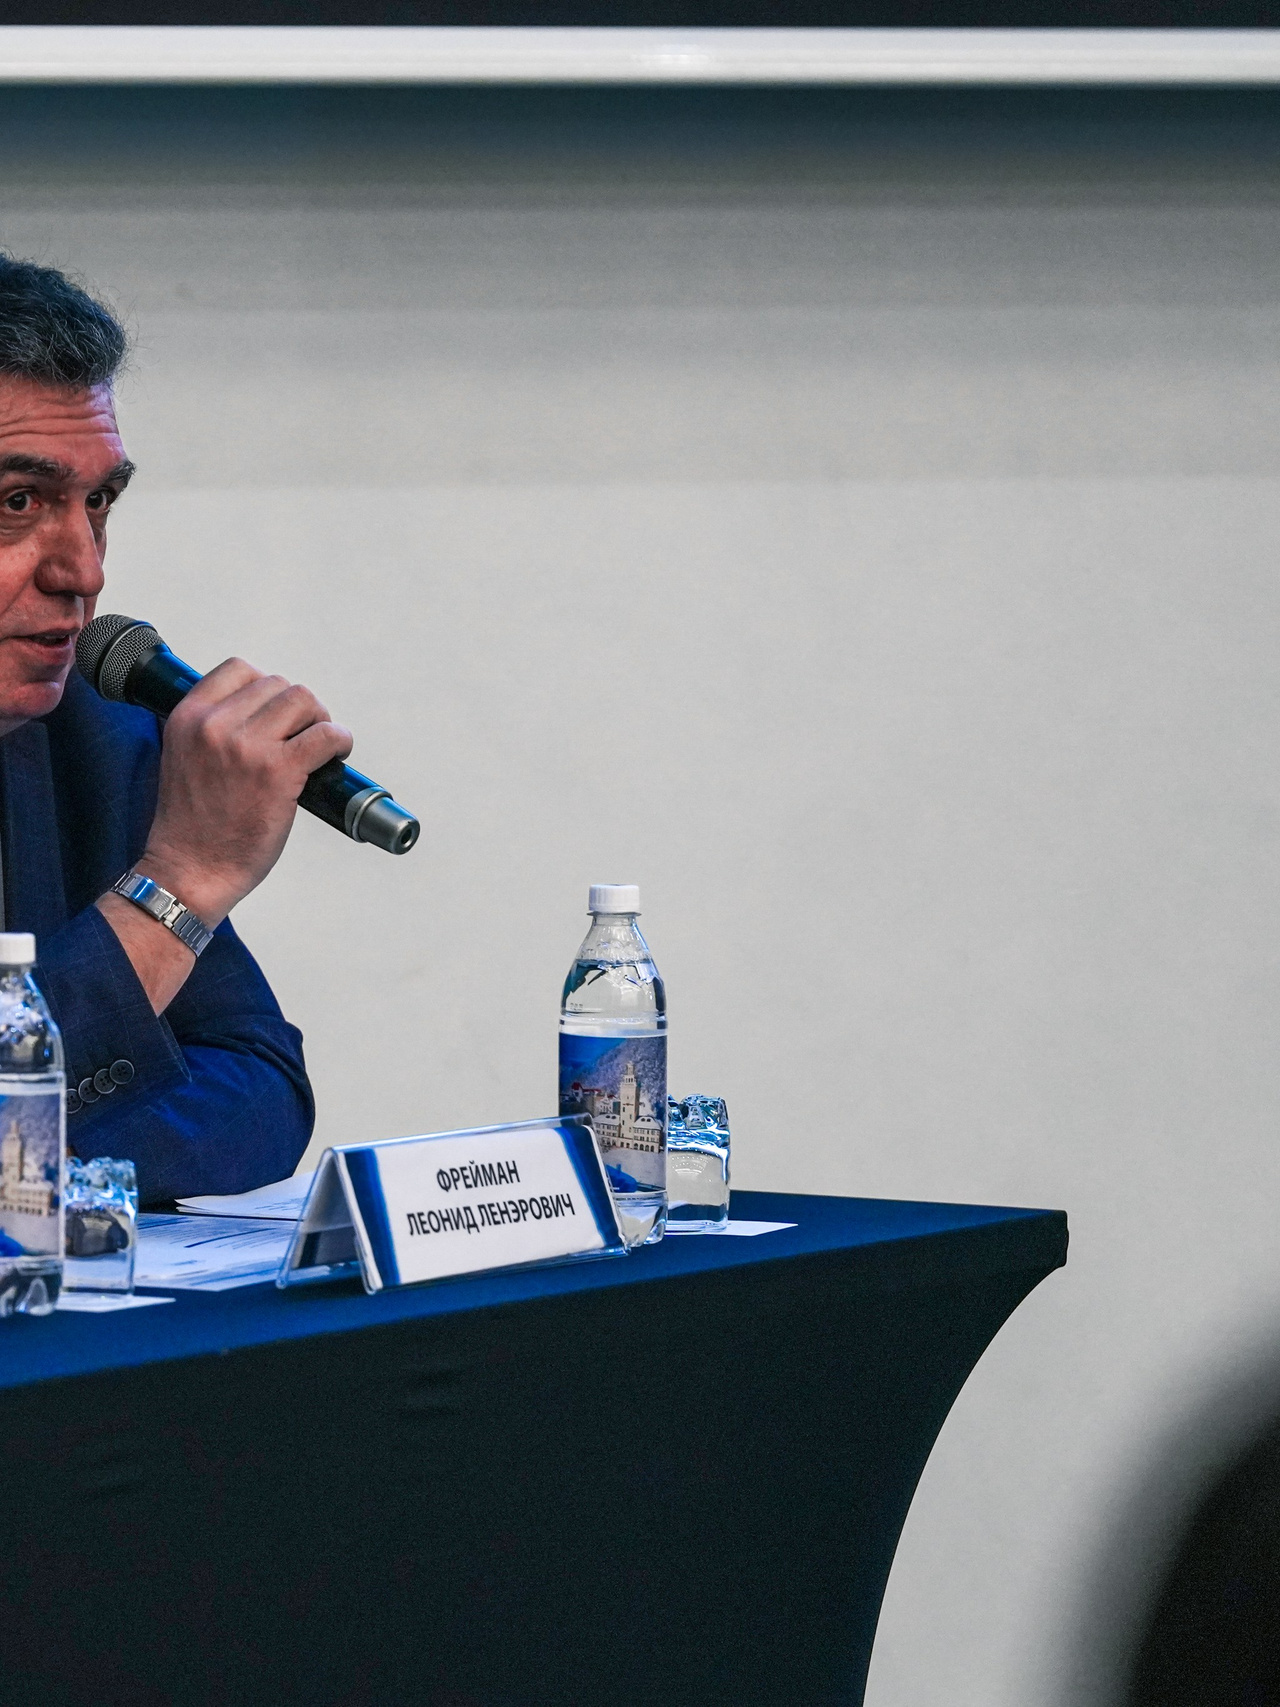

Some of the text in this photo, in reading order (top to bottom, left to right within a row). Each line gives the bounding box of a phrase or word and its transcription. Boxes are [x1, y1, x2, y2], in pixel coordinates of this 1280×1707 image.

[436, 1160, 521, 1193] ФРЕЙМАН
[406, 1193, 576, 1236] ЛЕОНИД ЛЕНЭРОВИЧ
